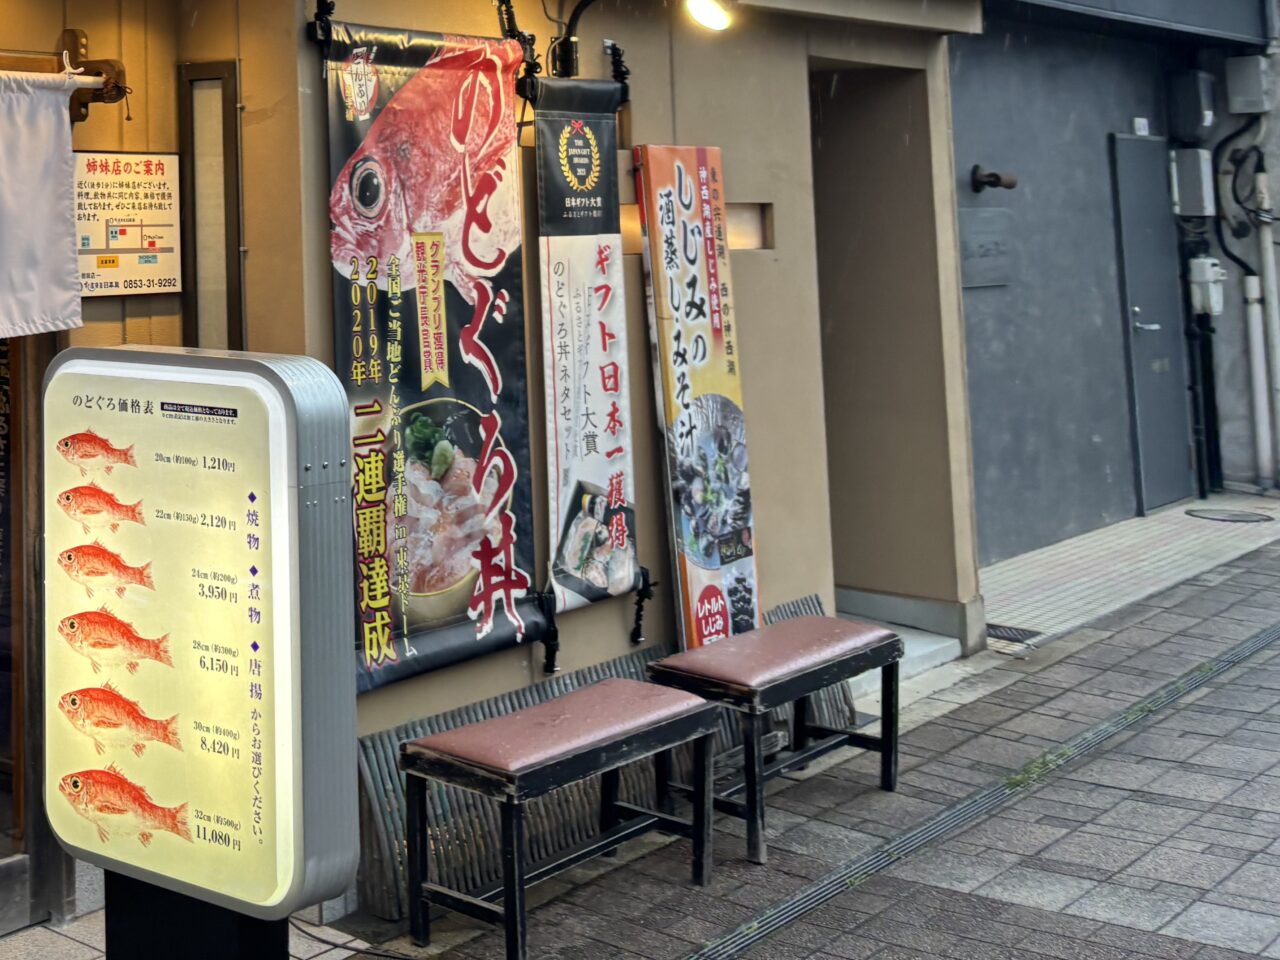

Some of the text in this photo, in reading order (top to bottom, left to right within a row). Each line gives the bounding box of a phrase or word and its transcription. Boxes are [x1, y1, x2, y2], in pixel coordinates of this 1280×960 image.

[86, 158, 166, 177] 姉妹店のご案内
[676, 163, 707, 363] しじみの
[350, 255, 367, 387] 2020年
[366, 255, 383, 385] 2019年
[450, 50, 531, 642] のどぐろ丼
[72, 394, 154, 415] のどぐろ価格表
[594, 244, 628, 550] ギフト日本一獲得
[202, 455, 236, 473] 1,210円
[200, 513, 237, 531] 2,120円
[246, 509, 260, 551] 焼物
[353, 399, 399, 670] 二連覇達成
[198, 583, 238, 603] 3,950円
[248, 583, 261, 624] 煮物
[697, 595, 725, 618] レトルト
[702, 614, 724, 636] しじみ
[199, 655, 239, 677] 6,150円
[200, 737, 240, 760] 8,420円
[195, 825, 241, 851] 11,080円
